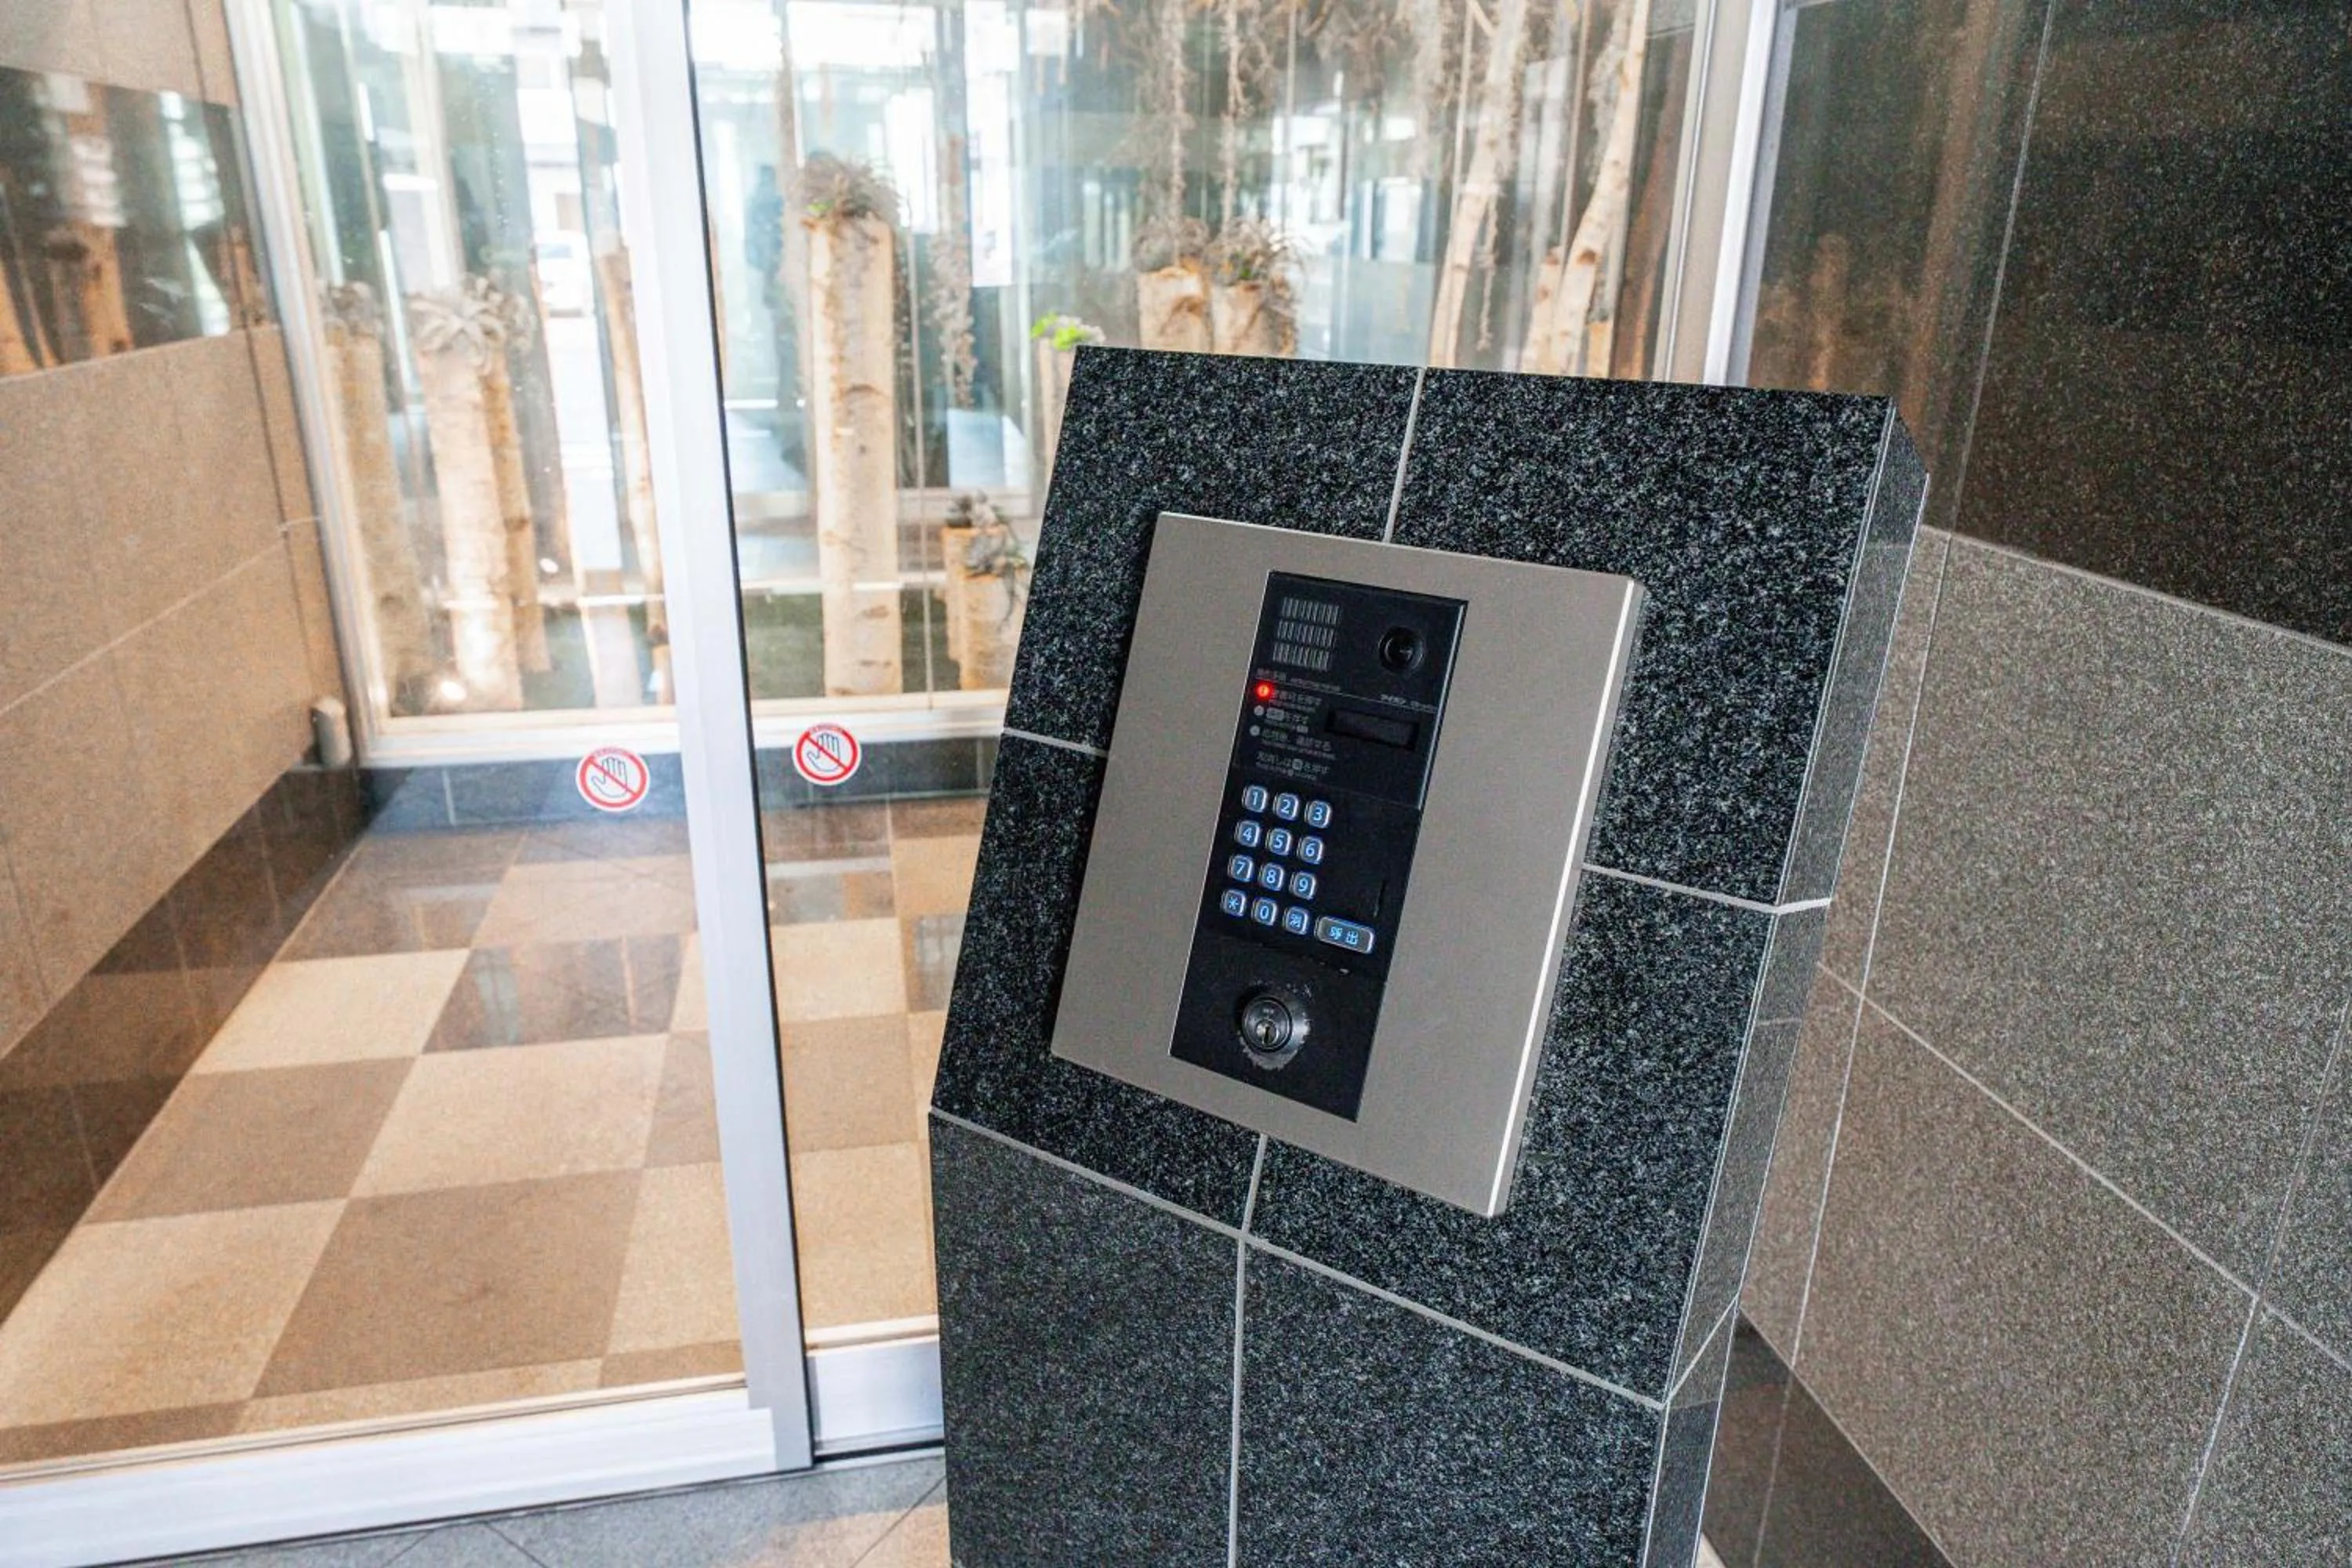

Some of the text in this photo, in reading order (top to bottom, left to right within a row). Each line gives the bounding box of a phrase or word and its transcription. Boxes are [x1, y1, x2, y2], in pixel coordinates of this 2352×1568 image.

[1252, 792, 1322, 821] 1 2 3
[1243, 827, 1314, 856] 4 5 6
[1236, 862, 1308, 891] 7 8 9
[1260, 906, 1269, 919] 0
